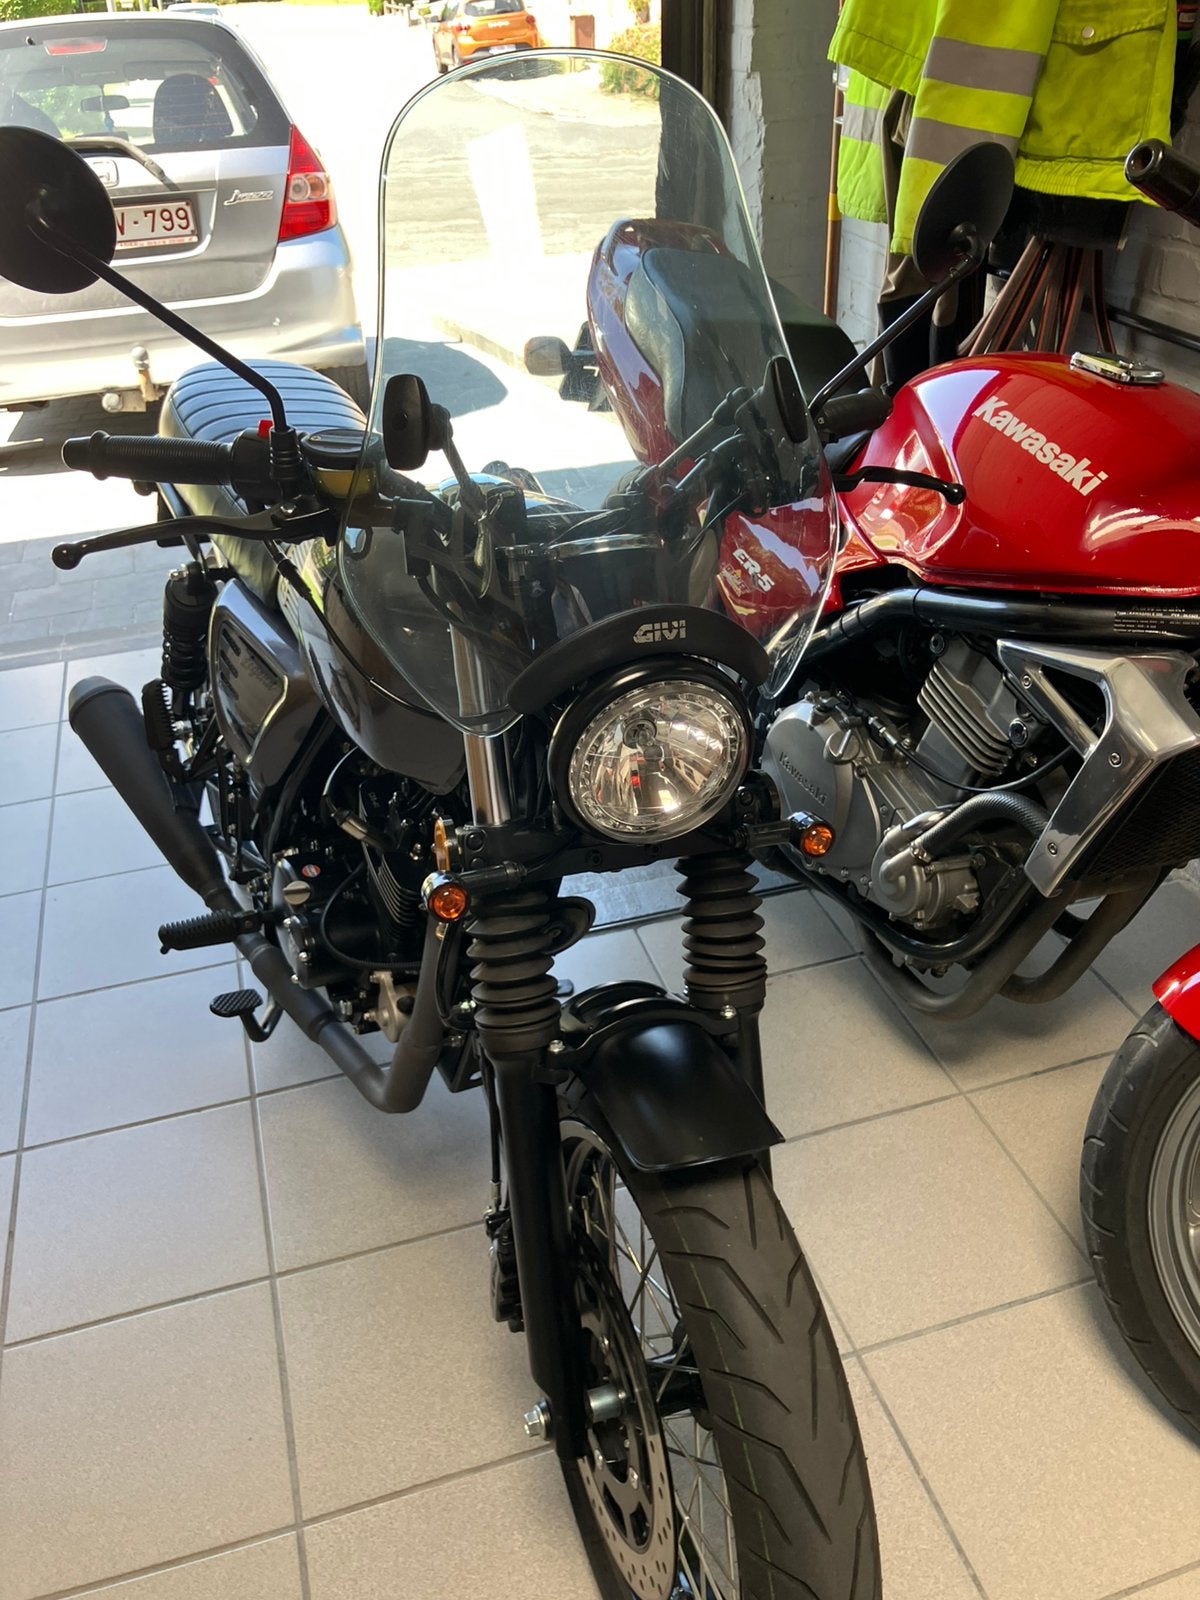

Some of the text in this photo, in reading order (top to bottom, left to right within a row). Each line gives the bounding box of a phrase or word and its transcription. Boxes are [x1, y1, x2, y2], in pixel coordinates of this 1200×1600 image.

[972, 395, 1109, 496] Kawasaki
[732, 548, 775, 592] ER-5
[633, 619, 686, 643] GIVI
